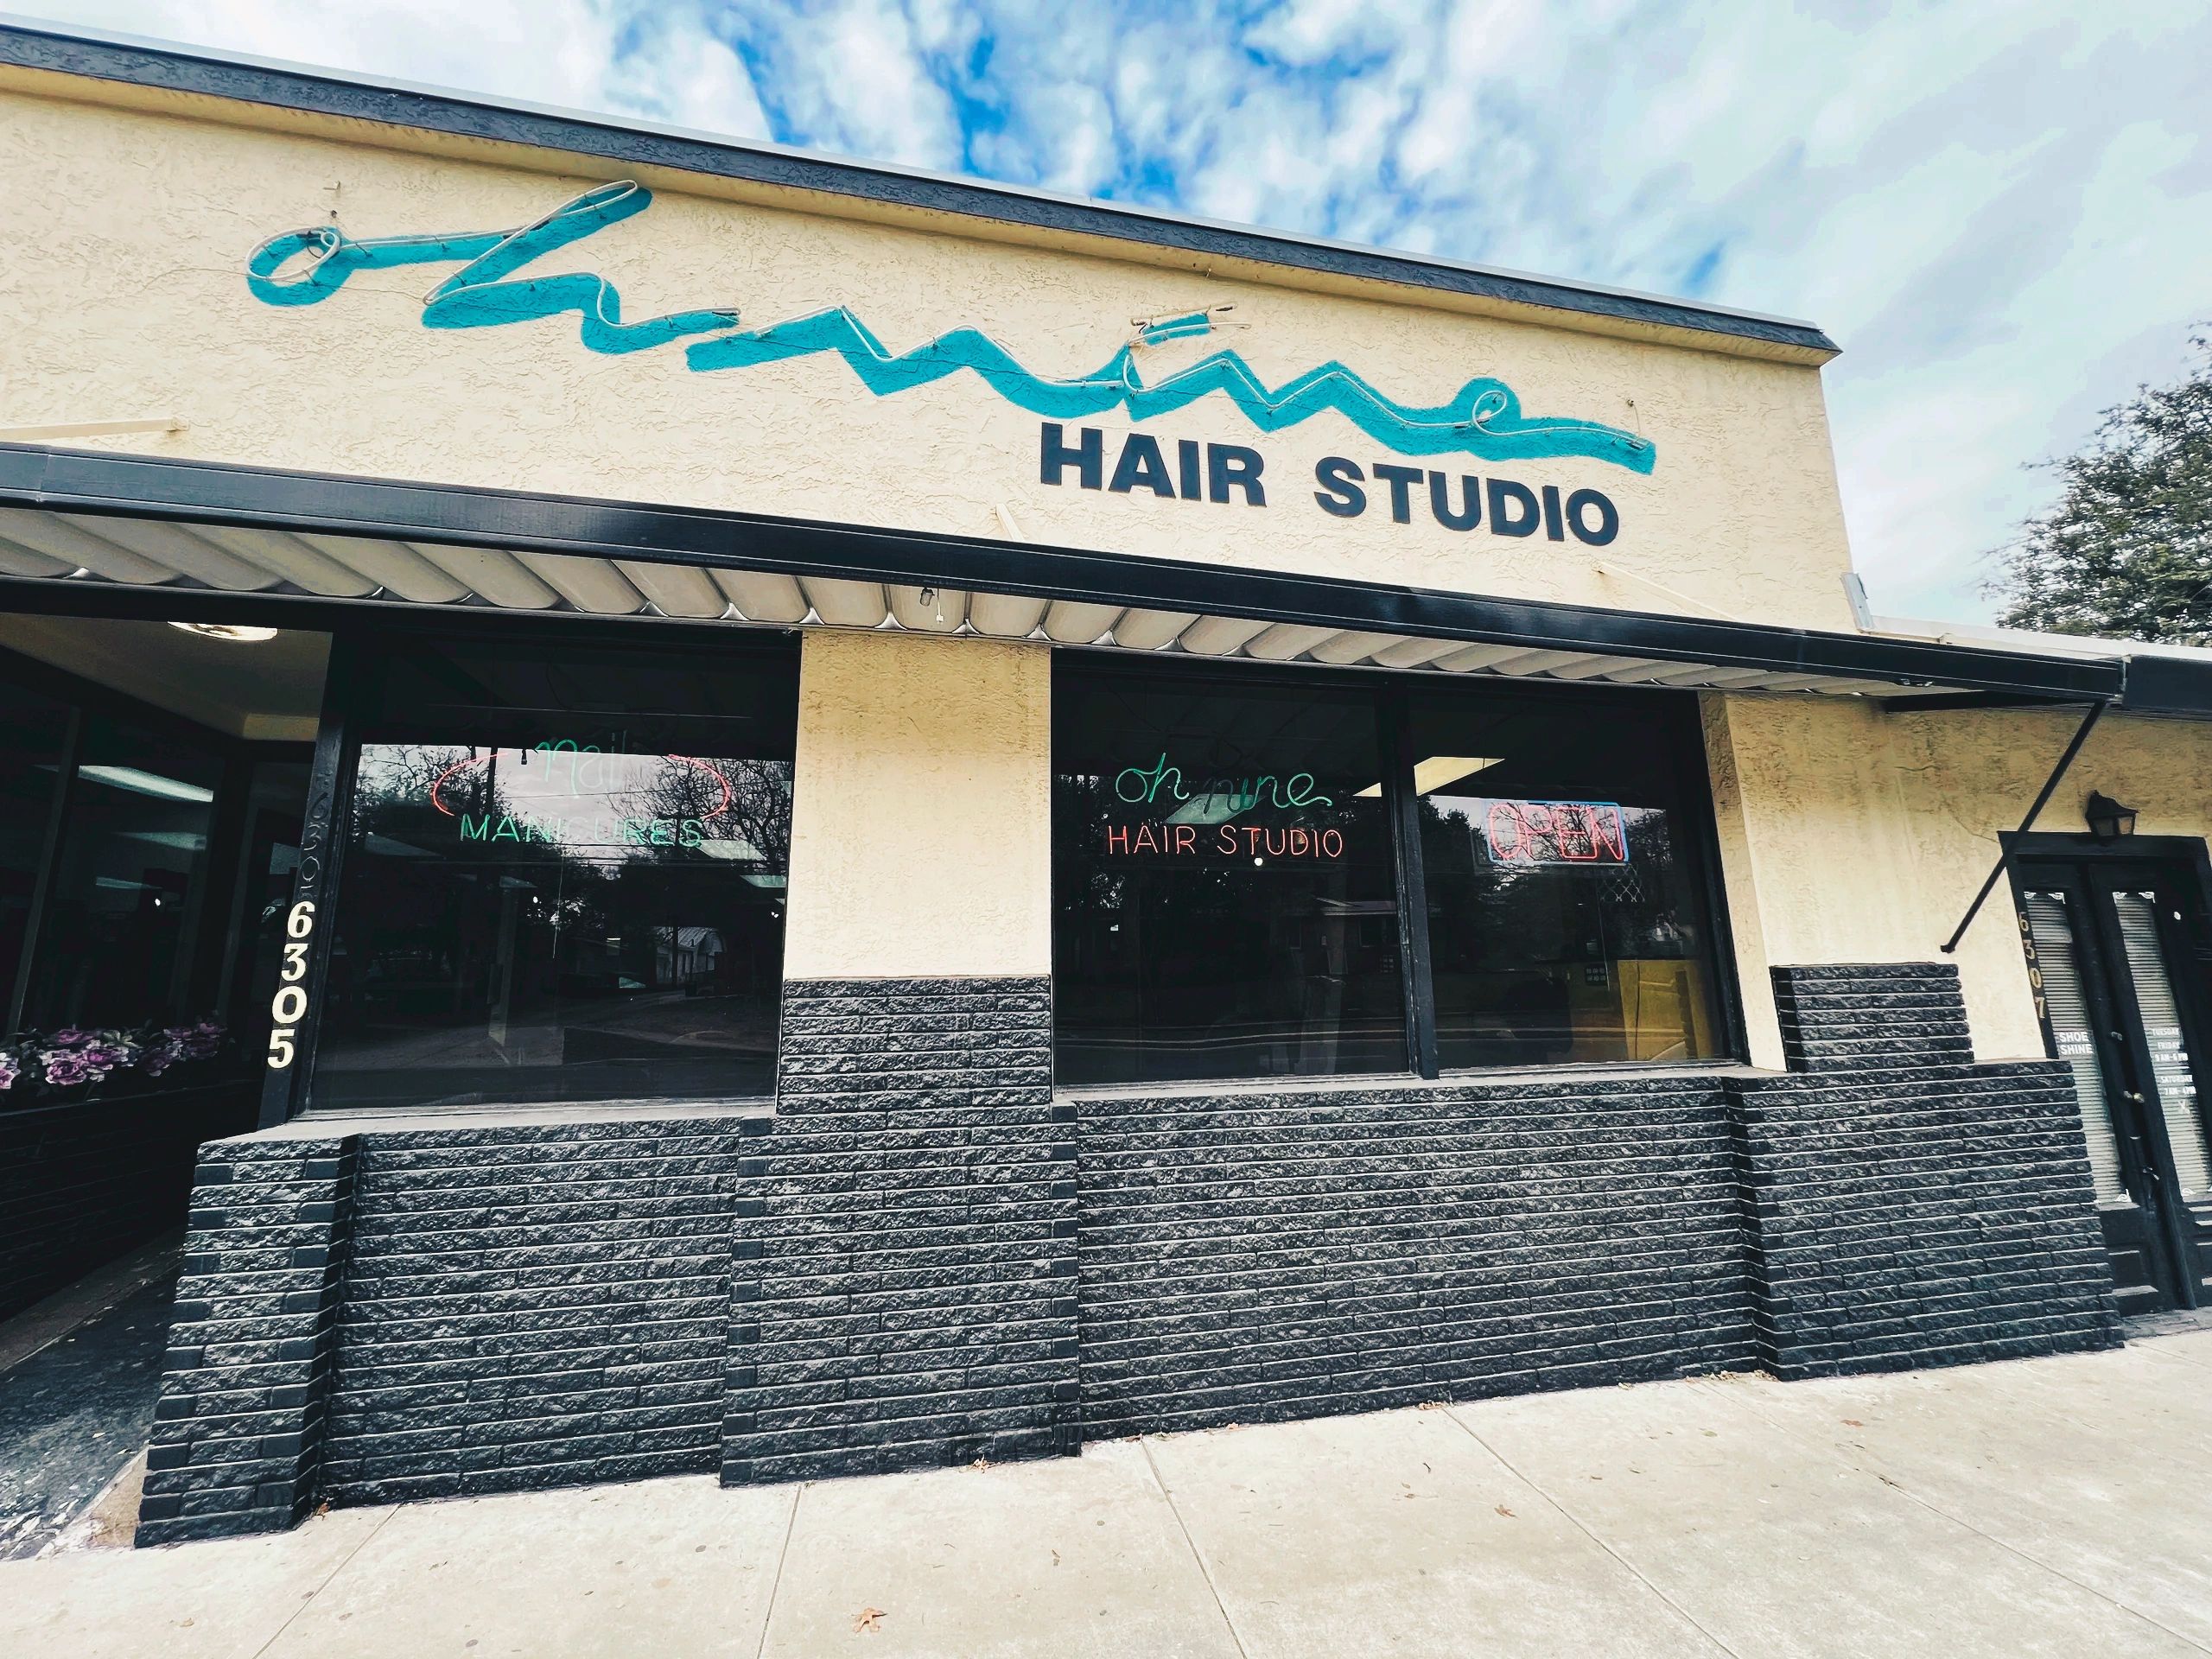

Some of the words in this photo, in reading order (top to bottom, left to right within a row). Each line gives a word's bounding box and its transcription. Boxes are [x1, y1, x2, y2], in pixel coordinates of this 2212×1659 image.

[1040, 422, 1268, 509] HAIR
[1313, 454, 1620, 548] STUDIO
[460, 812, 703, 849] MANICURES
[1108, 824, 1196, 855] HAIR
[1217, 823, 1344, 859] STUDIO
[1490, 802, 1624, 861] OPEN
[2018, 911, 2046, 1020] 6307
[267, 900, 316, 1070] 6305
[2059, 1031, 2090, 1043] SHOE
[2060, 1043, 2094, 1056] SHINE
[2152, 1027, 2180, 1036] TUESDAY
[2157, 1041, 2181, 1050] FRIDAY
[2160, 1074, 2193, 1083] SATURDAY
